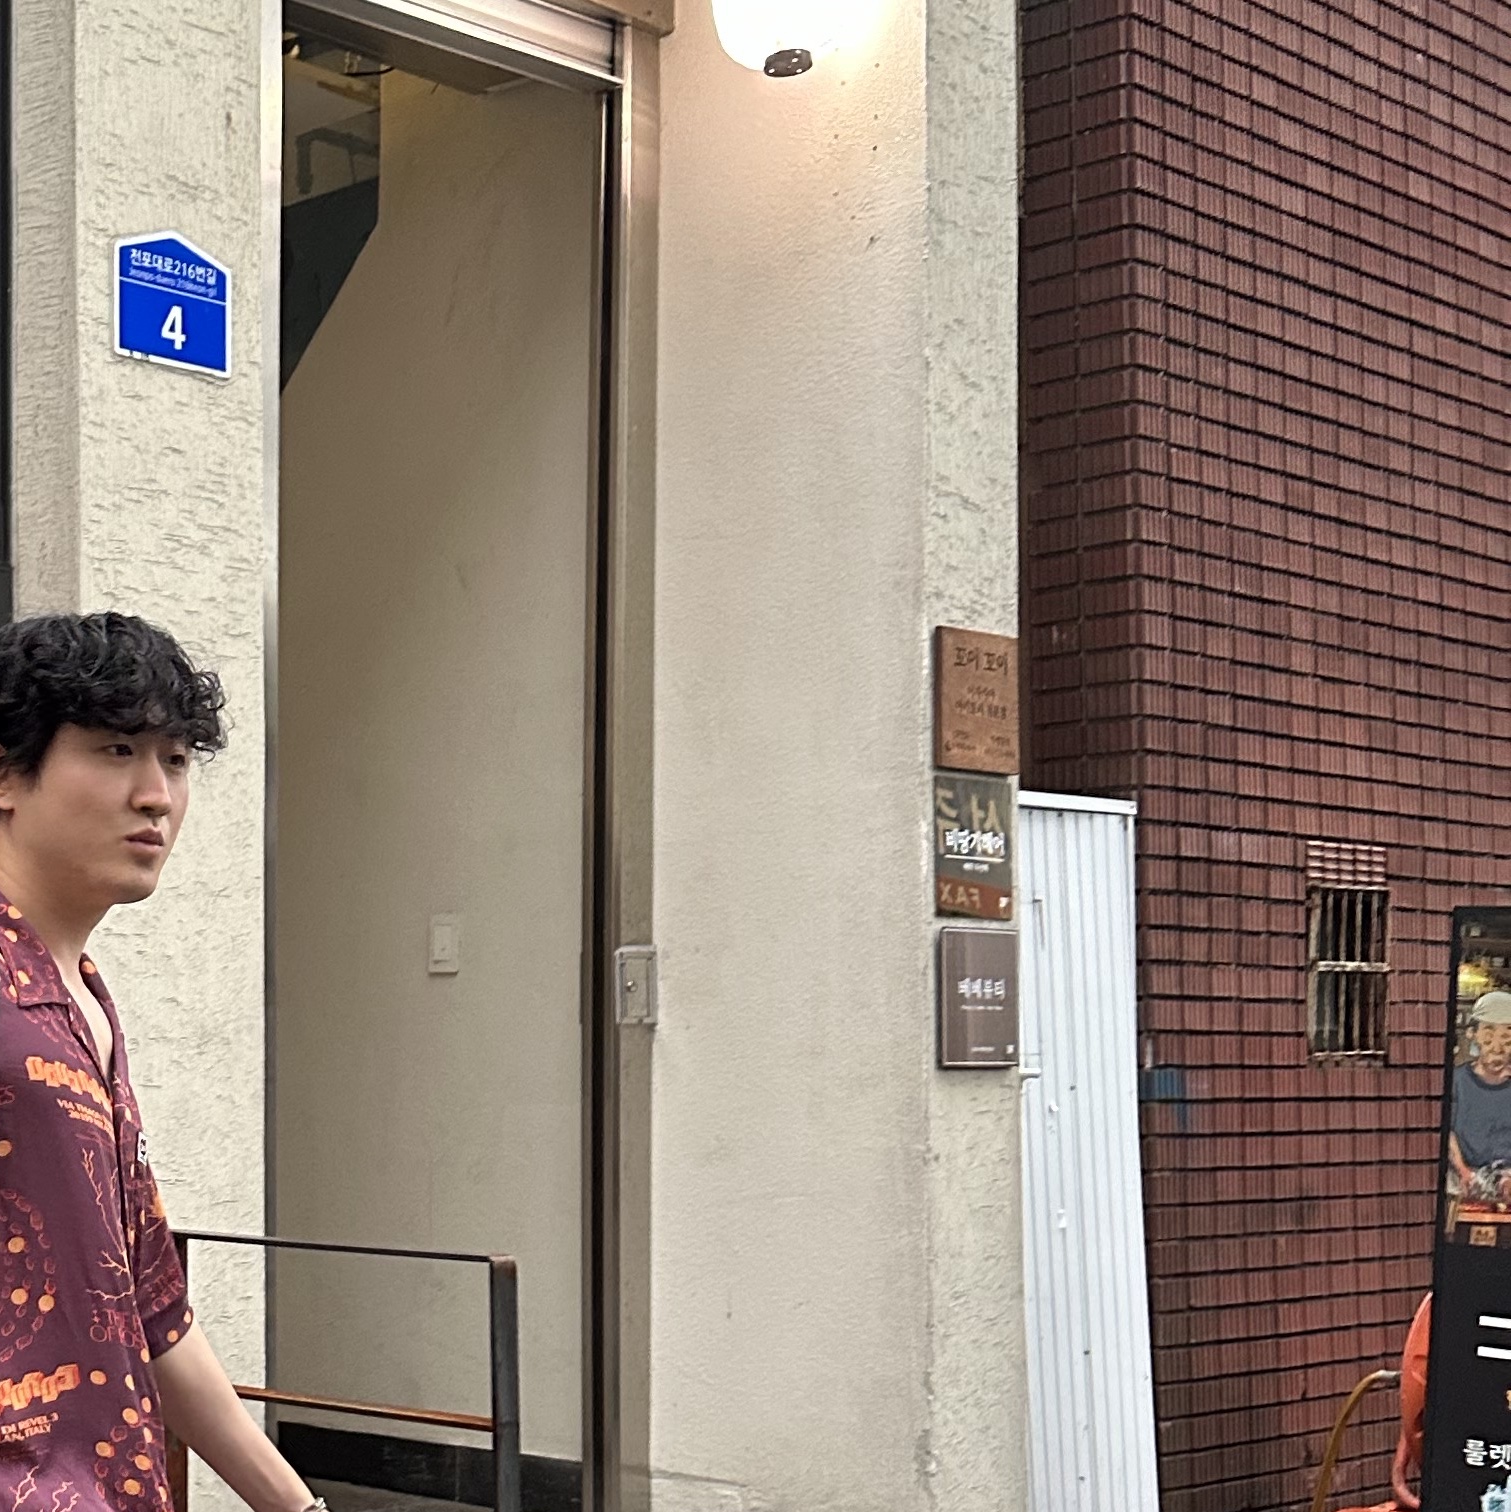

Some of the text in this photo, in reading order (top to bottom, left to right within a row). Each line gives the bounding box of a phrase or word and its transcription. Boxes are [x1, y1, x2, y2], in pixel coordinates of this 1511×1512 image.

[130, 248, 217, 286] 전포대로216번길
[161, 305, 187, 350] 4
[1, 1423, 16, 1435] DI
